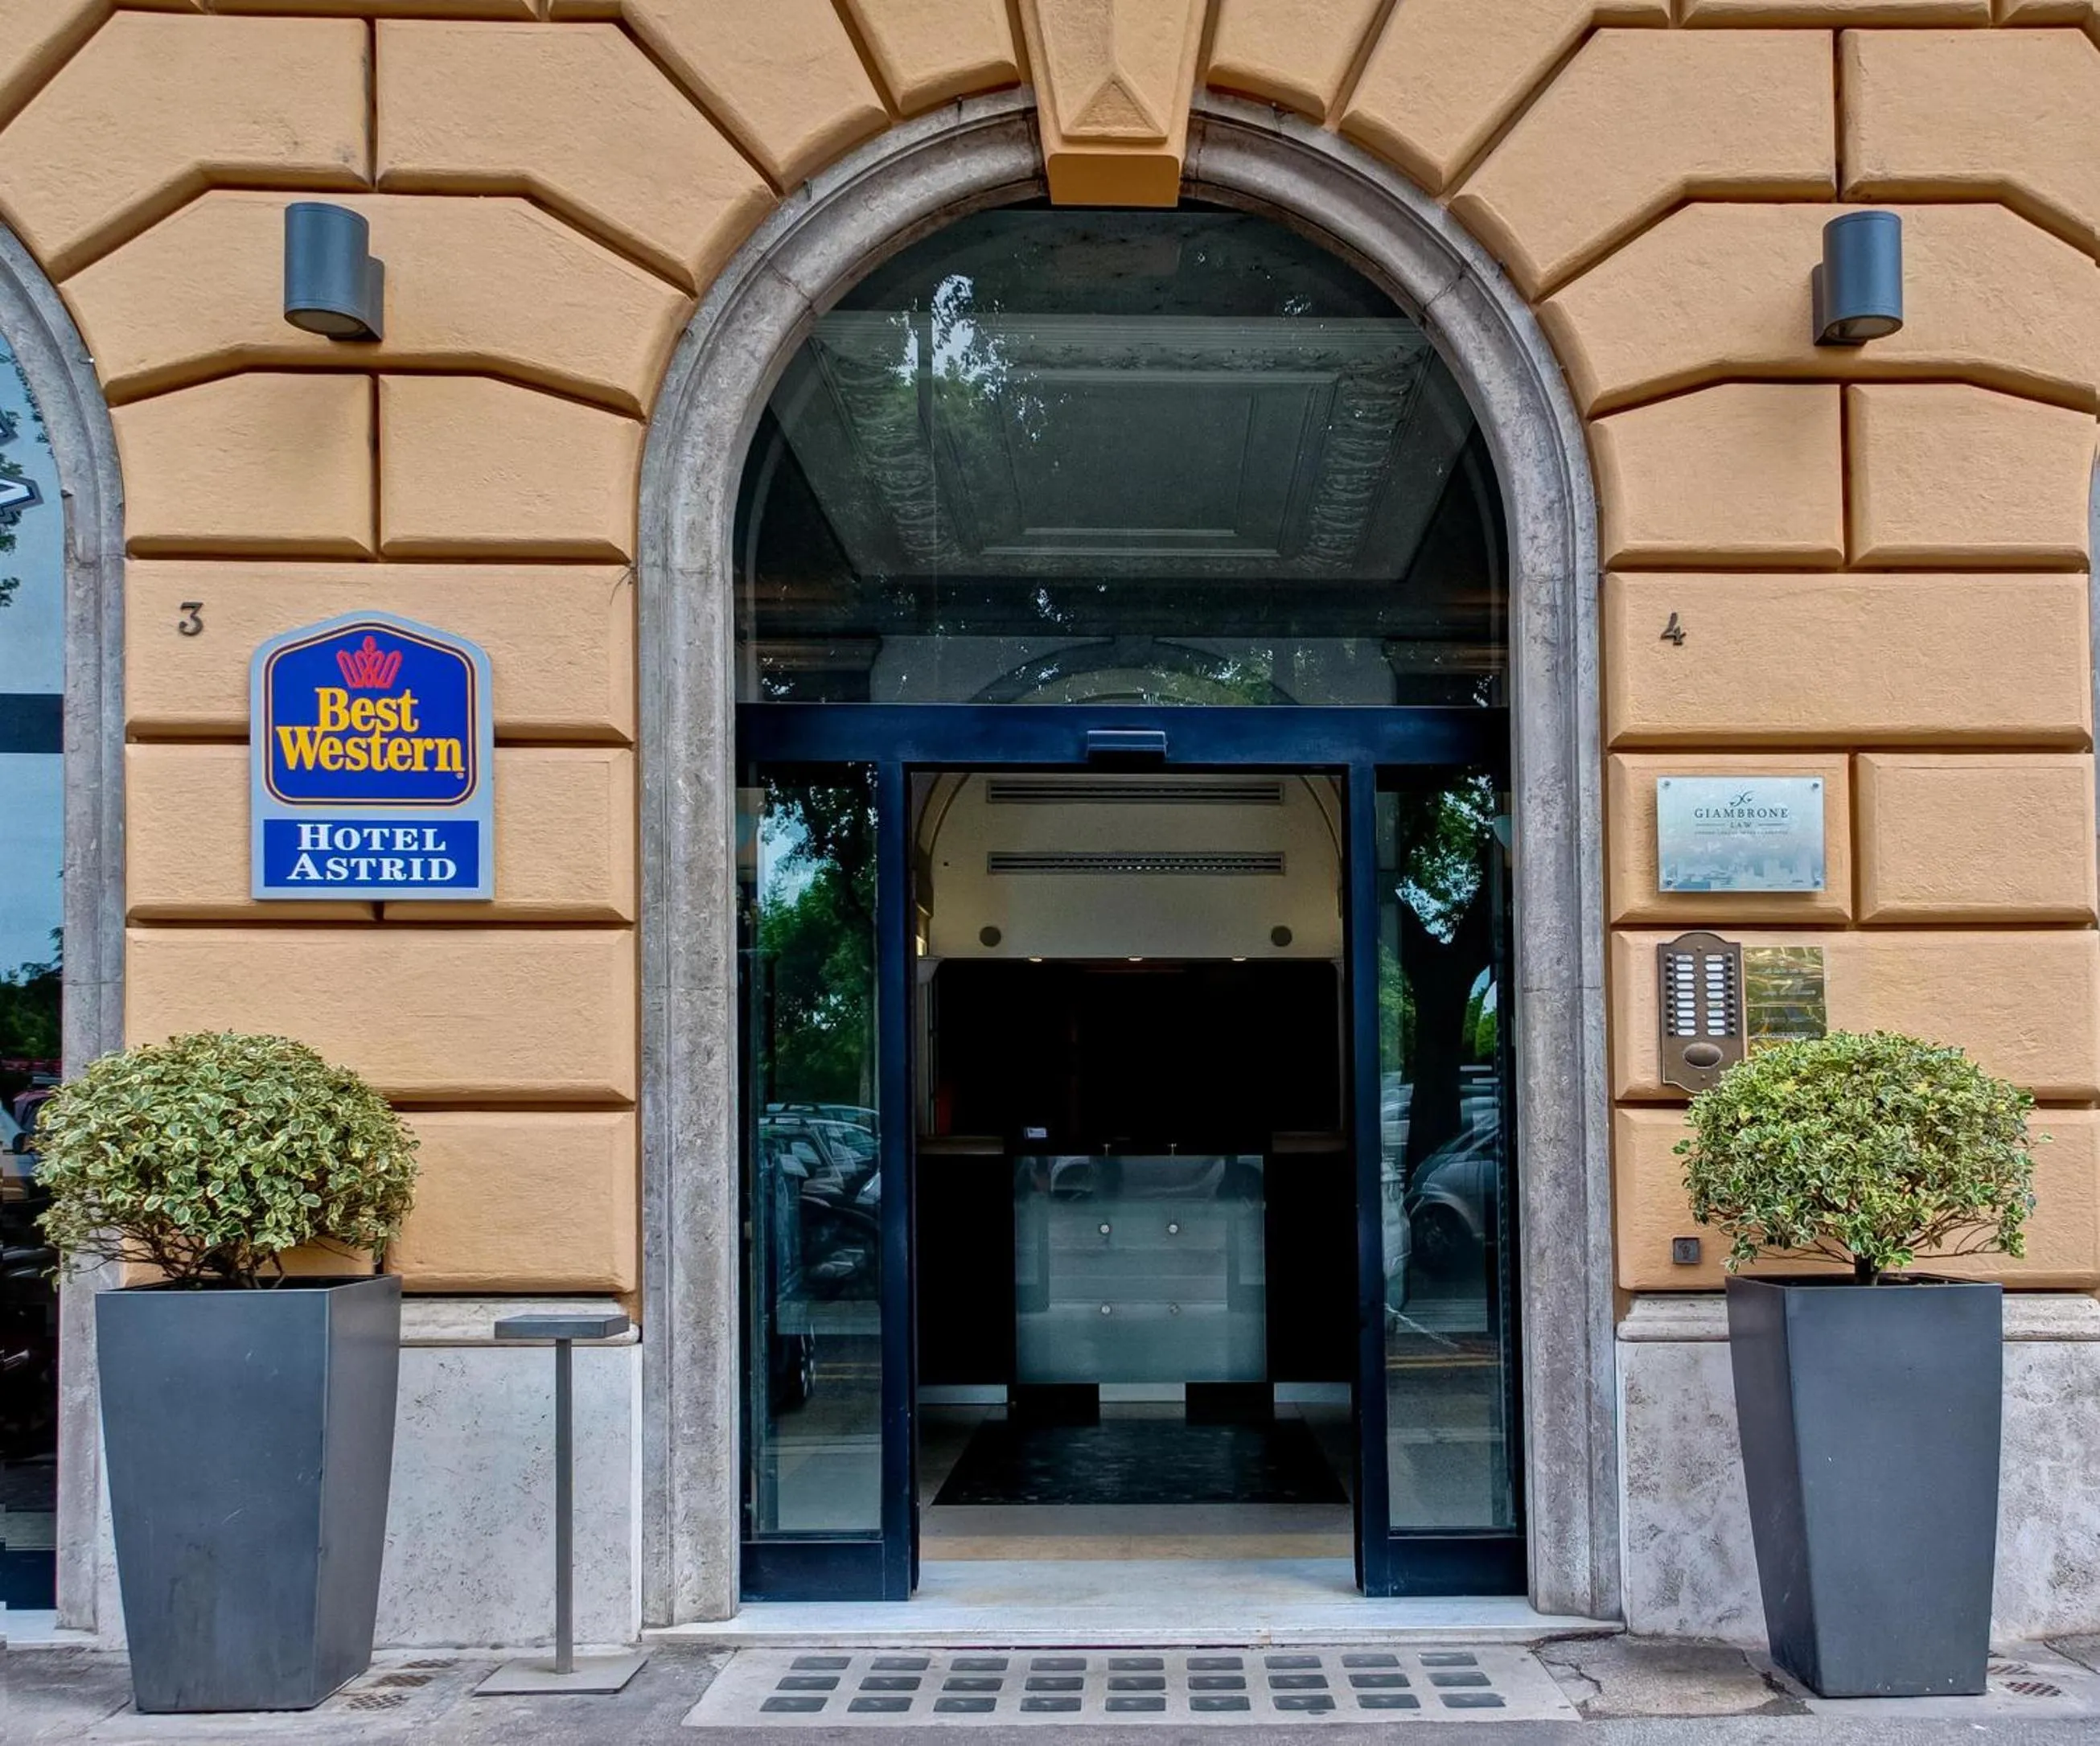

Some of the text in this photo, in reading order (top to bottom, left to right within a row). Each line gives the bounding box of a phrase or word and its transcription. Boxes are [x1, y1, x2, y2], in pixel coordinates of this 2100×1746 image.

[179, 602, 203, 637] 3
[1660, 611, 1687, 646] 4
[314, 687, 419, 733] Best
[276, 720, 466, 772] Western
[1694, 807, 1790, 819] GIAMBRONE
[297, 824, 446, 851] HOTEL
[286, 852, 457, 881] ASTRID
